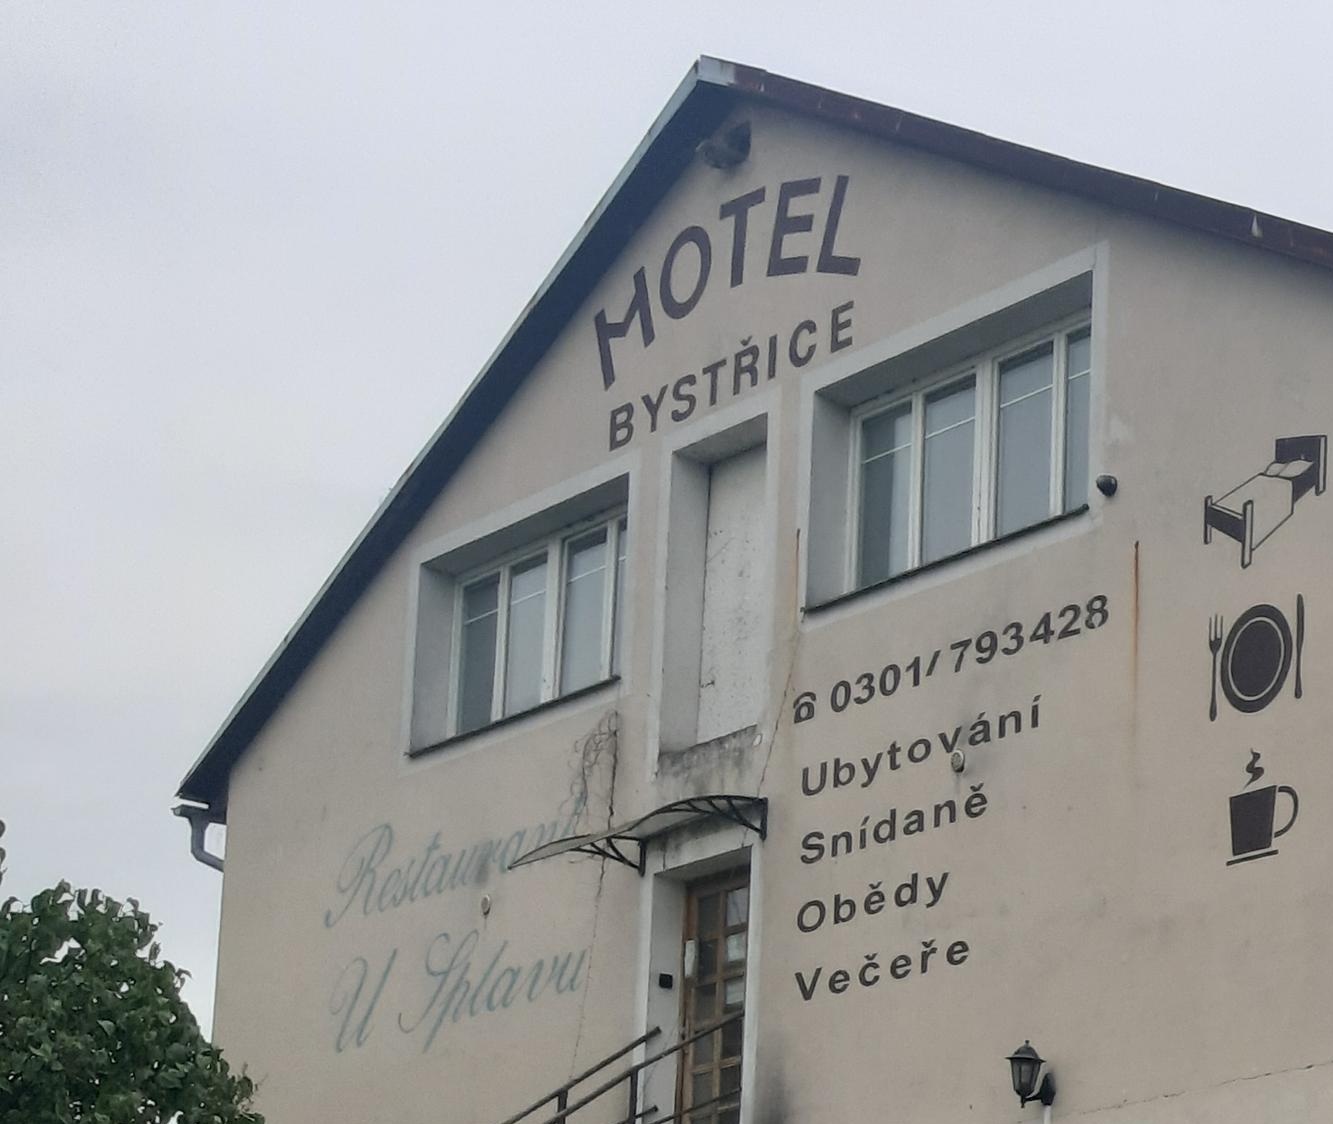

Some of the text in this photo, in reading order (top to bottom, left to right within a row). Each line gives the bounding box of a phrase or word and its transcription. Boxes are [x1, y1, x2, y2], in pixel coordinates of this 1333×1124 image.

[594, 175, 862, 391] MOTEL
[608, 300, 855, 452] BYSTŘICE
[801, 695, 1042, 797] Ubytování
[800, 783, 989, 865] Snídaně
[796, 871, 950, 934] Obědy
[330, 929, 587, 1054] U Splavu
[794, 938, 971, 1002] Večeře
